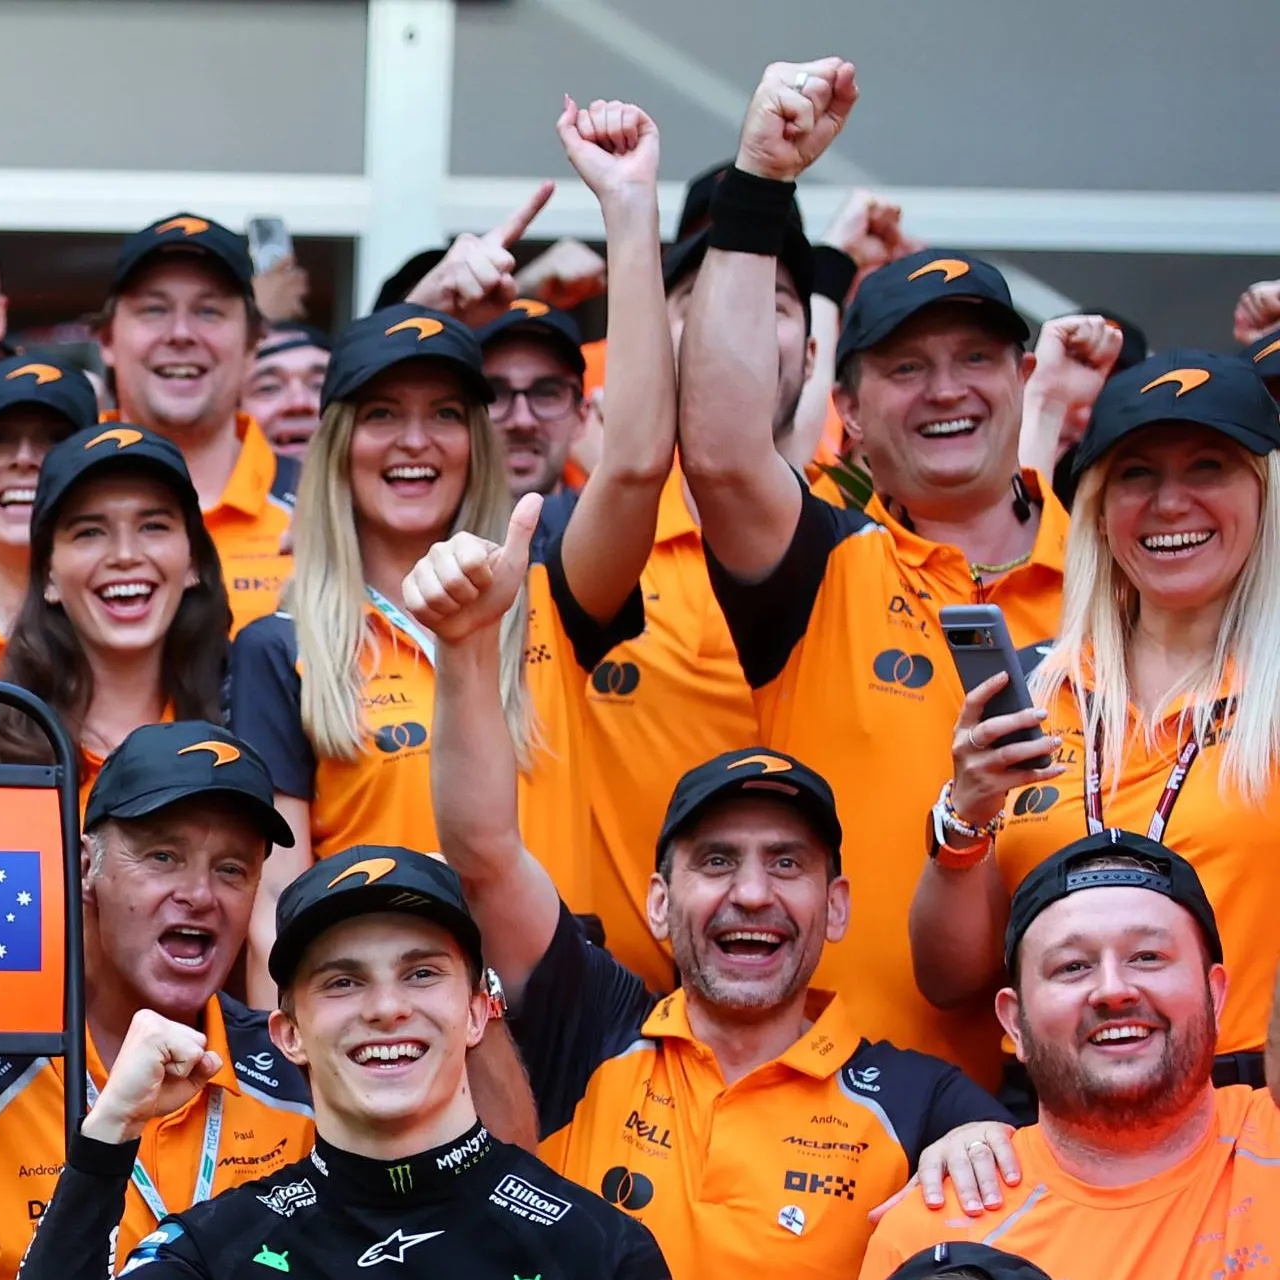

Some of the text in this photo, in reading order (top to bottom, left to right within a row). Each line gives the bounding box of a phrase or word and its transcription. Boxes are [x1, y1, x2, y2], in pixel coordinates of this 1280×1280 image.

[235, 1060, 279, 1088] DP WORLD
[233, 1130, 255, 1141] Paul
[625, 1110, 672, 1149] DELL
[810, 1115, 849, 1129] Andrea
[218, 1148, 282, 1168] McLaren
[782, 1136, 861, 1153] McLaren
[503, 1179, 560, 1217] Hilton
[784, 1170, 856, 1201] OKX
[489, 1194, 554, 1226] FOR THE STAY
